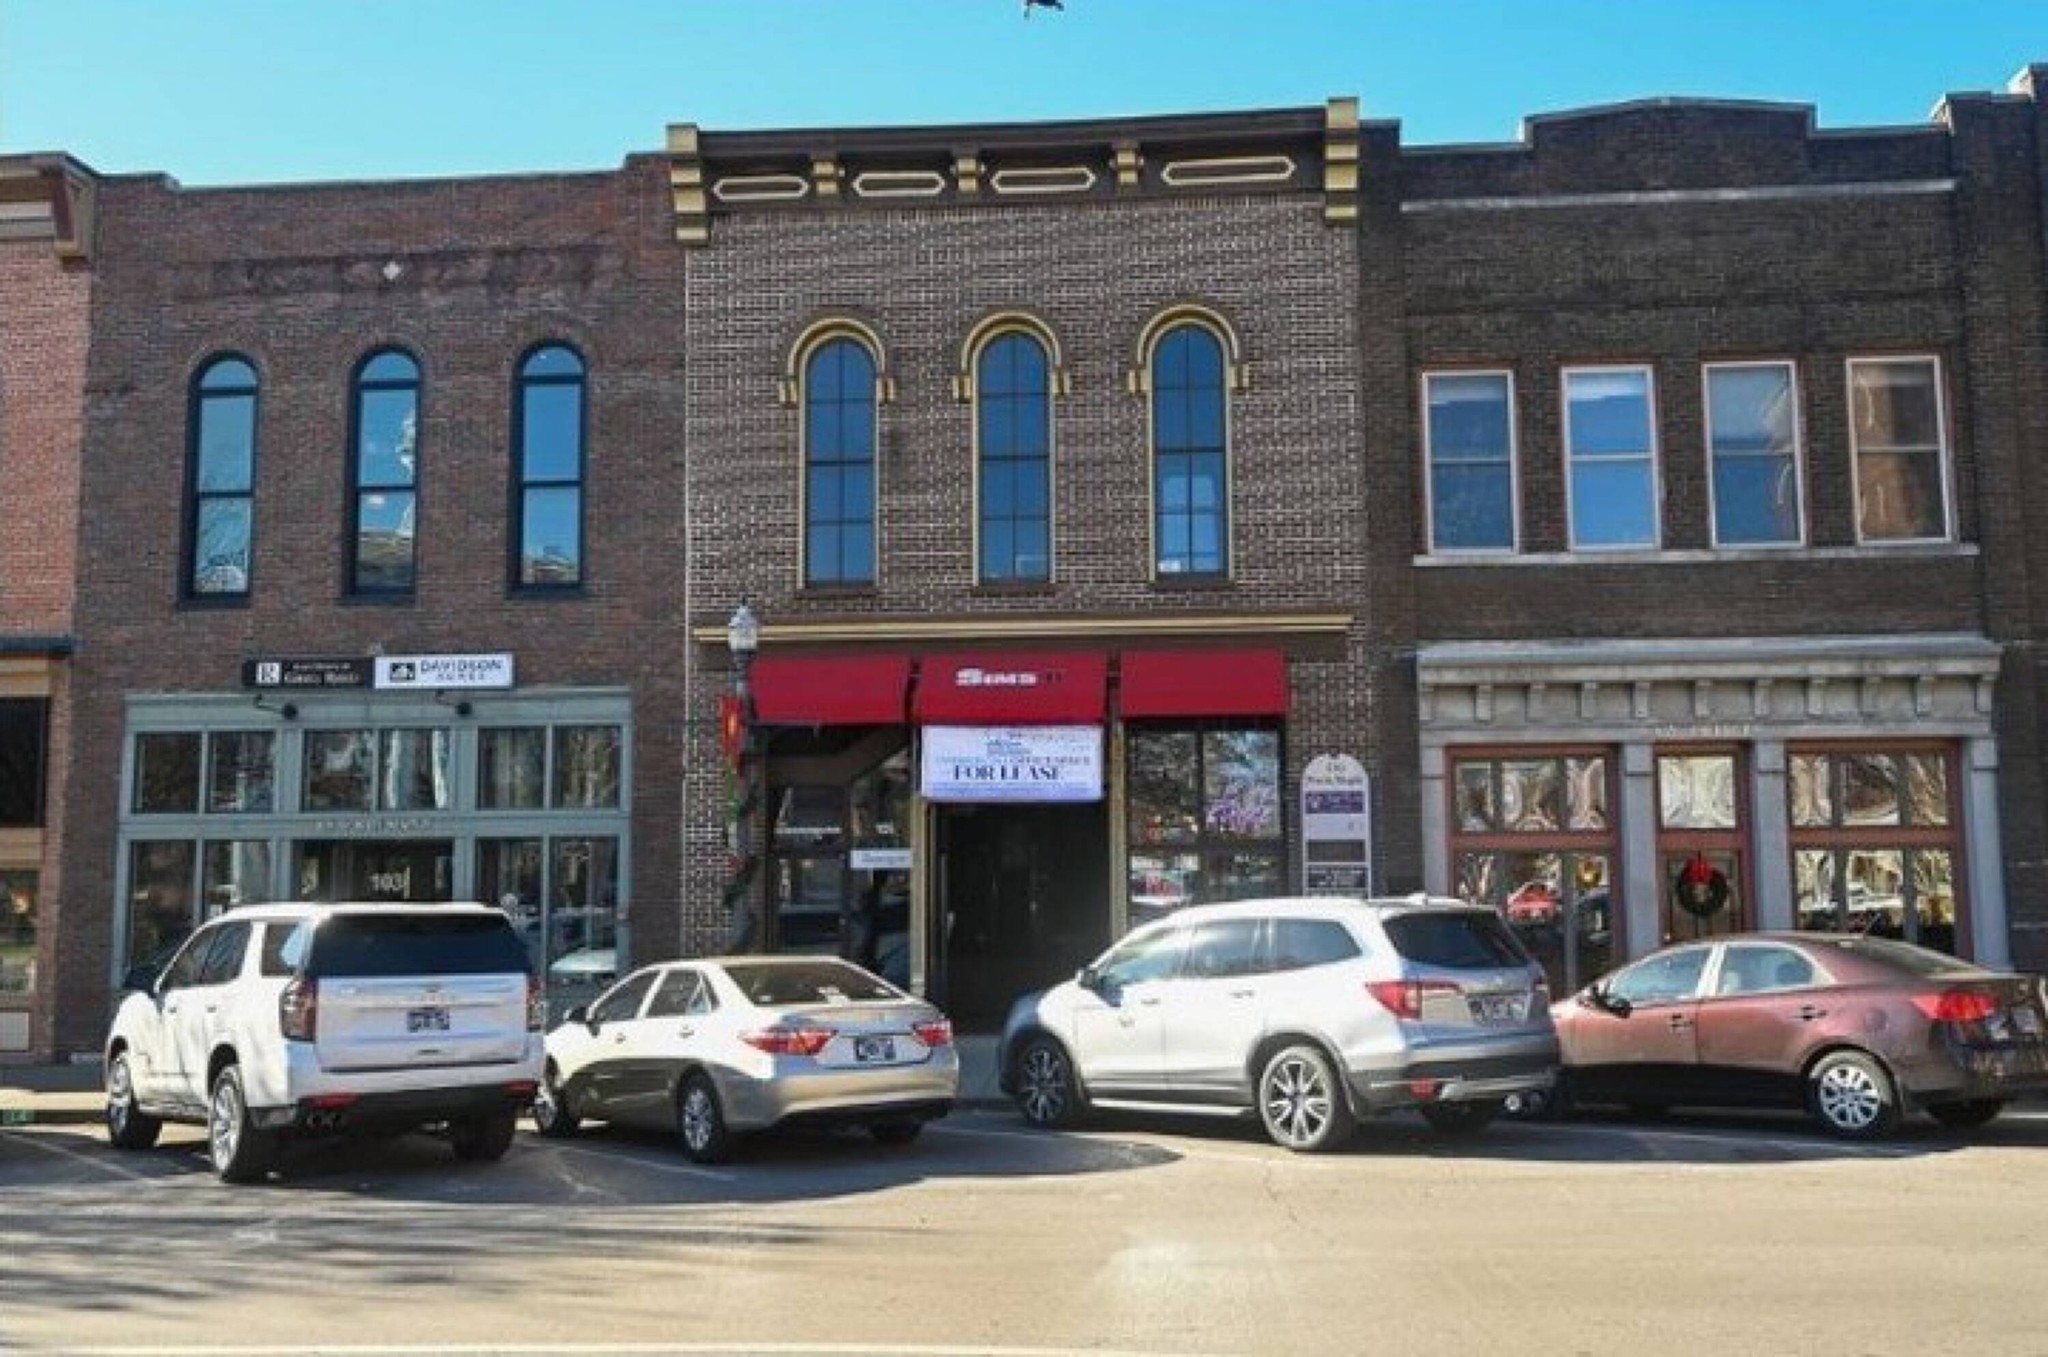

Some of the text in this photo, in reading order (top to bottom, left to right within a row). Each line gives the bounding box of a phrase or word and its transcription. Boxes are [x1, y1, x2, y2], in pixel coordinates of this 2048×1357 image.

[421, 659, 502, 673] DAVIDSON
[954, 765, 1060, 781] FOR LEASE
